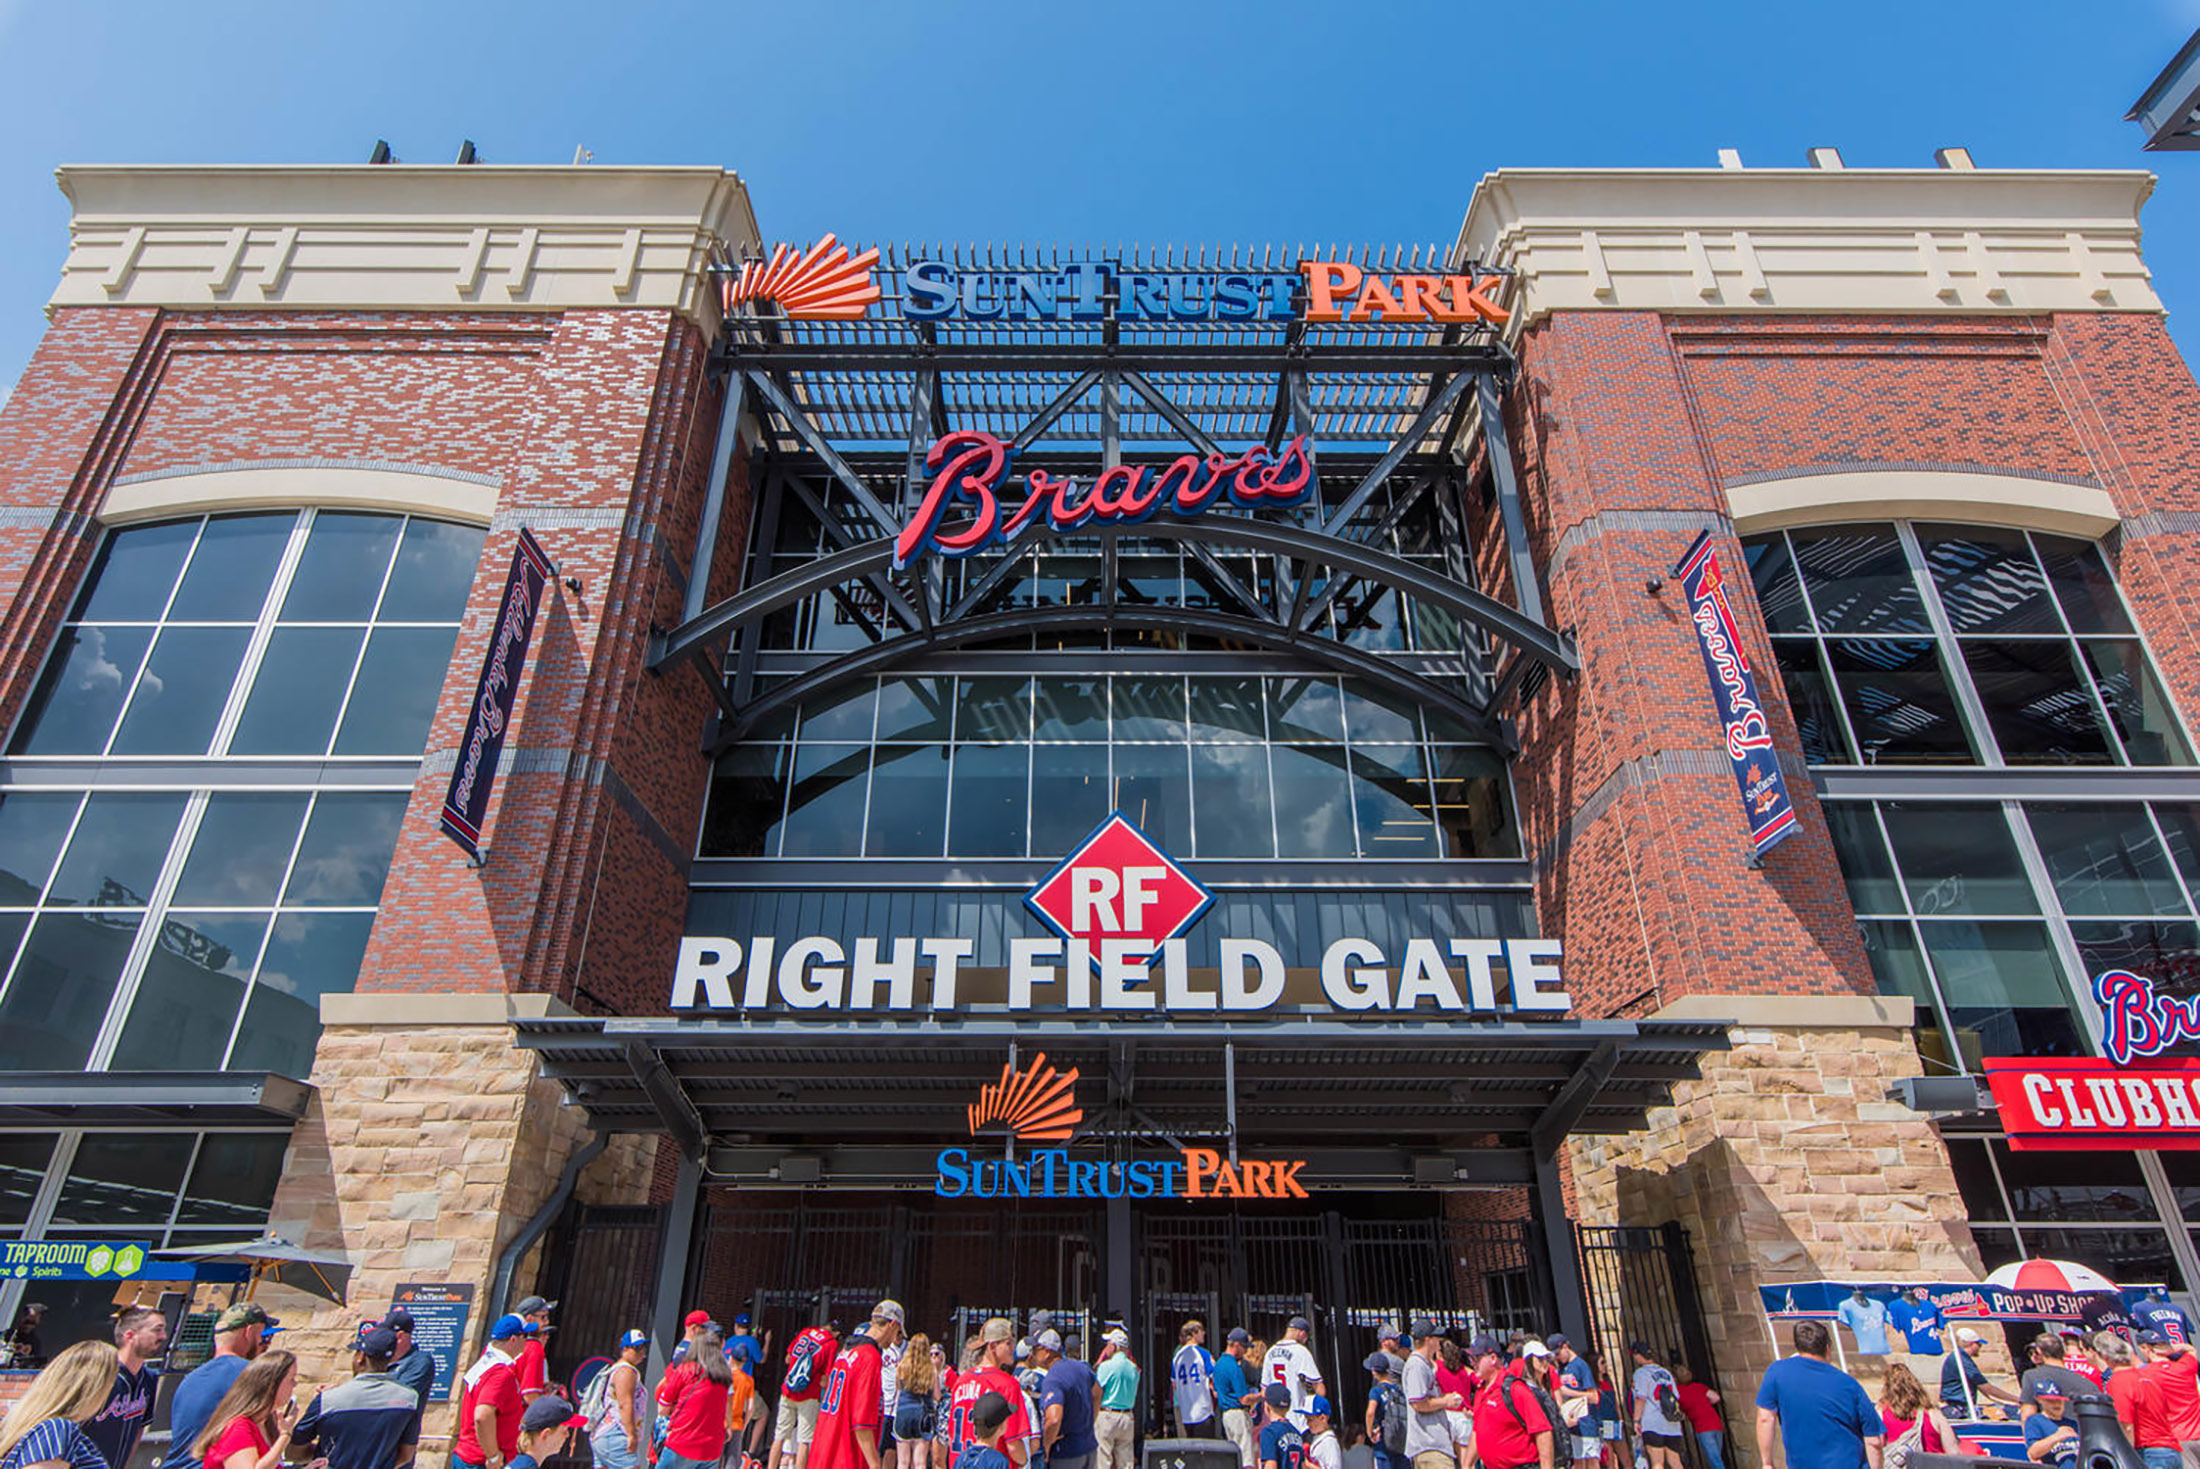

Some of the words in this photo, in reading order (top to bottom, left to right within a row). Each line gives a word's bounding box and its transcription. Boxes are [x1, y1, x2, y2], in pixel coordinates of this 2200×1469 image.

[893, 429, 1314, 570] Braves
[488, 556, 531, 688] Atlanta
[1694, 601, 1772, 760] Braves
[455, 680, 503, 818] Braves
[1071, 866, 1167, 932] RF
[671, 936, 973, 1010] RIGHT
[1009, 938, 1286, 1011] FIELD
[1319, 938, 1572, 1011] GATE
[2094, 969, 2200, 1065] Br
[5, 1243, 87, 1264] TAPROOM
[32, 1266, 62, 1278] Spirits
[2164, 1323, 2184, 1345] 5
[822, 1368, 846, 1415] 13
[1178, 1363, 1201, 1384] 44
[1273, 1363, 1287, 1387] 5
